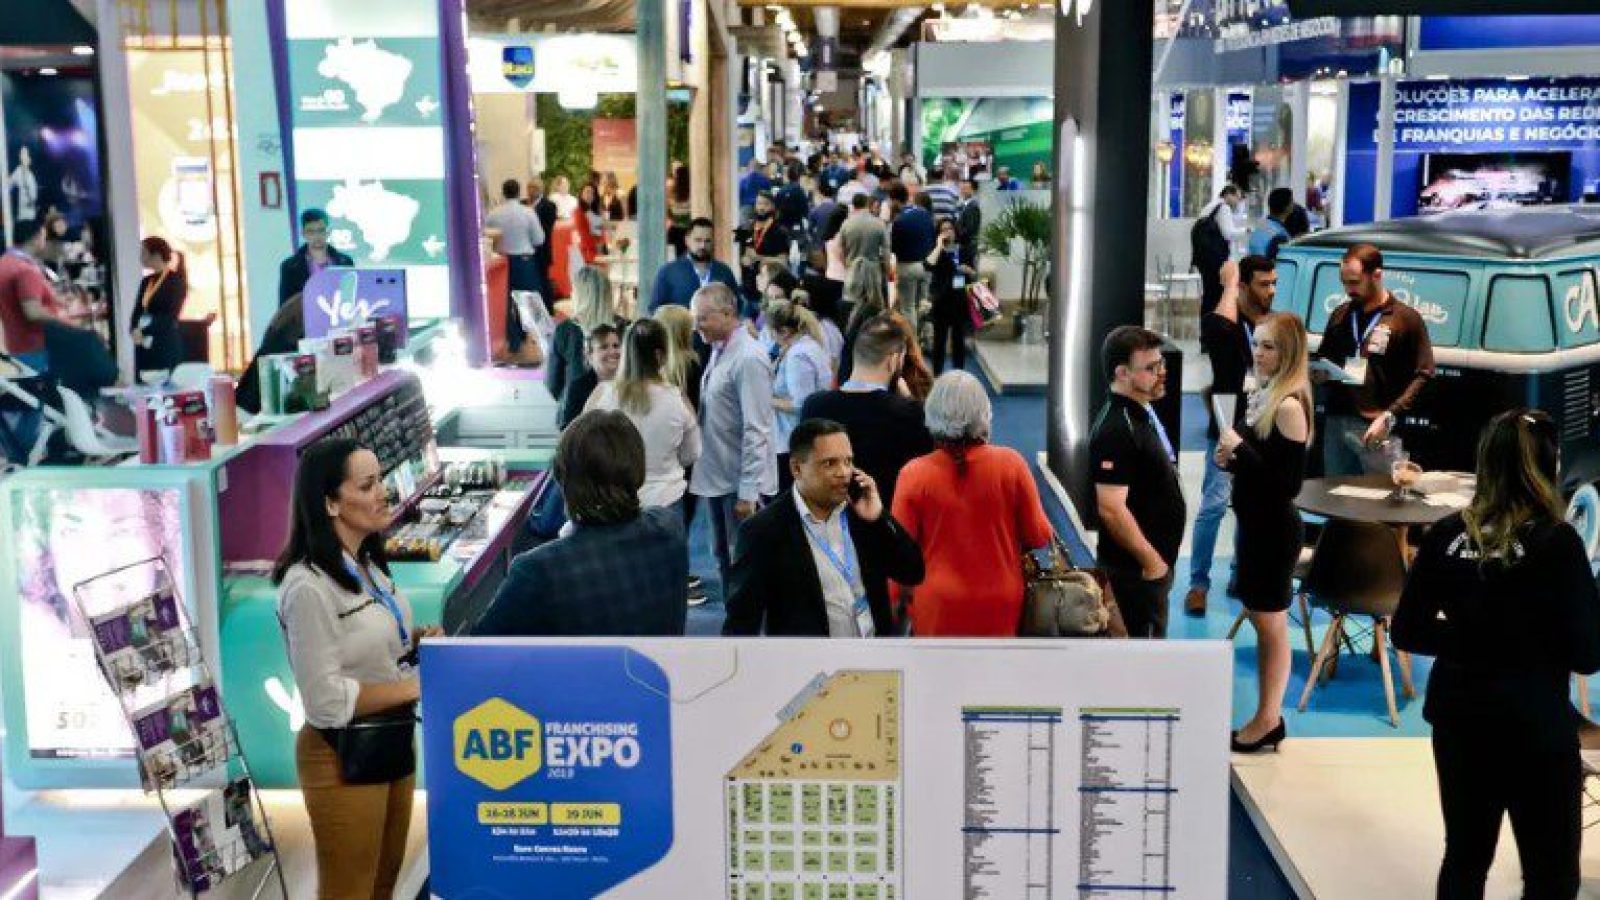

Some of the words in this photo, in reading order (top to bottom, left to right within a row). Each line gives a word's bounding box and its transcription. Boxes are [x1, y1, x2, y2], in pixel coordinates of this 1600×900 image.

[1395, 86, 1470, 105] OLUÇÕES
[1474, 87, 1521, 101] PARA
[1394, 108, 1516, 122] CRESCIMENTO
[1519, 107, 1553, 121] DAS
[1558, 106, 1600, 120] RED
[1402, 127, 1505, 144] FRANQUIAS
[1509, 127, 1520, 141] E
[545, 722, 638, 736] FRANCHISING
[462, 728, 534, 761] ABF
[546, 736, 640, 768] EXPO
